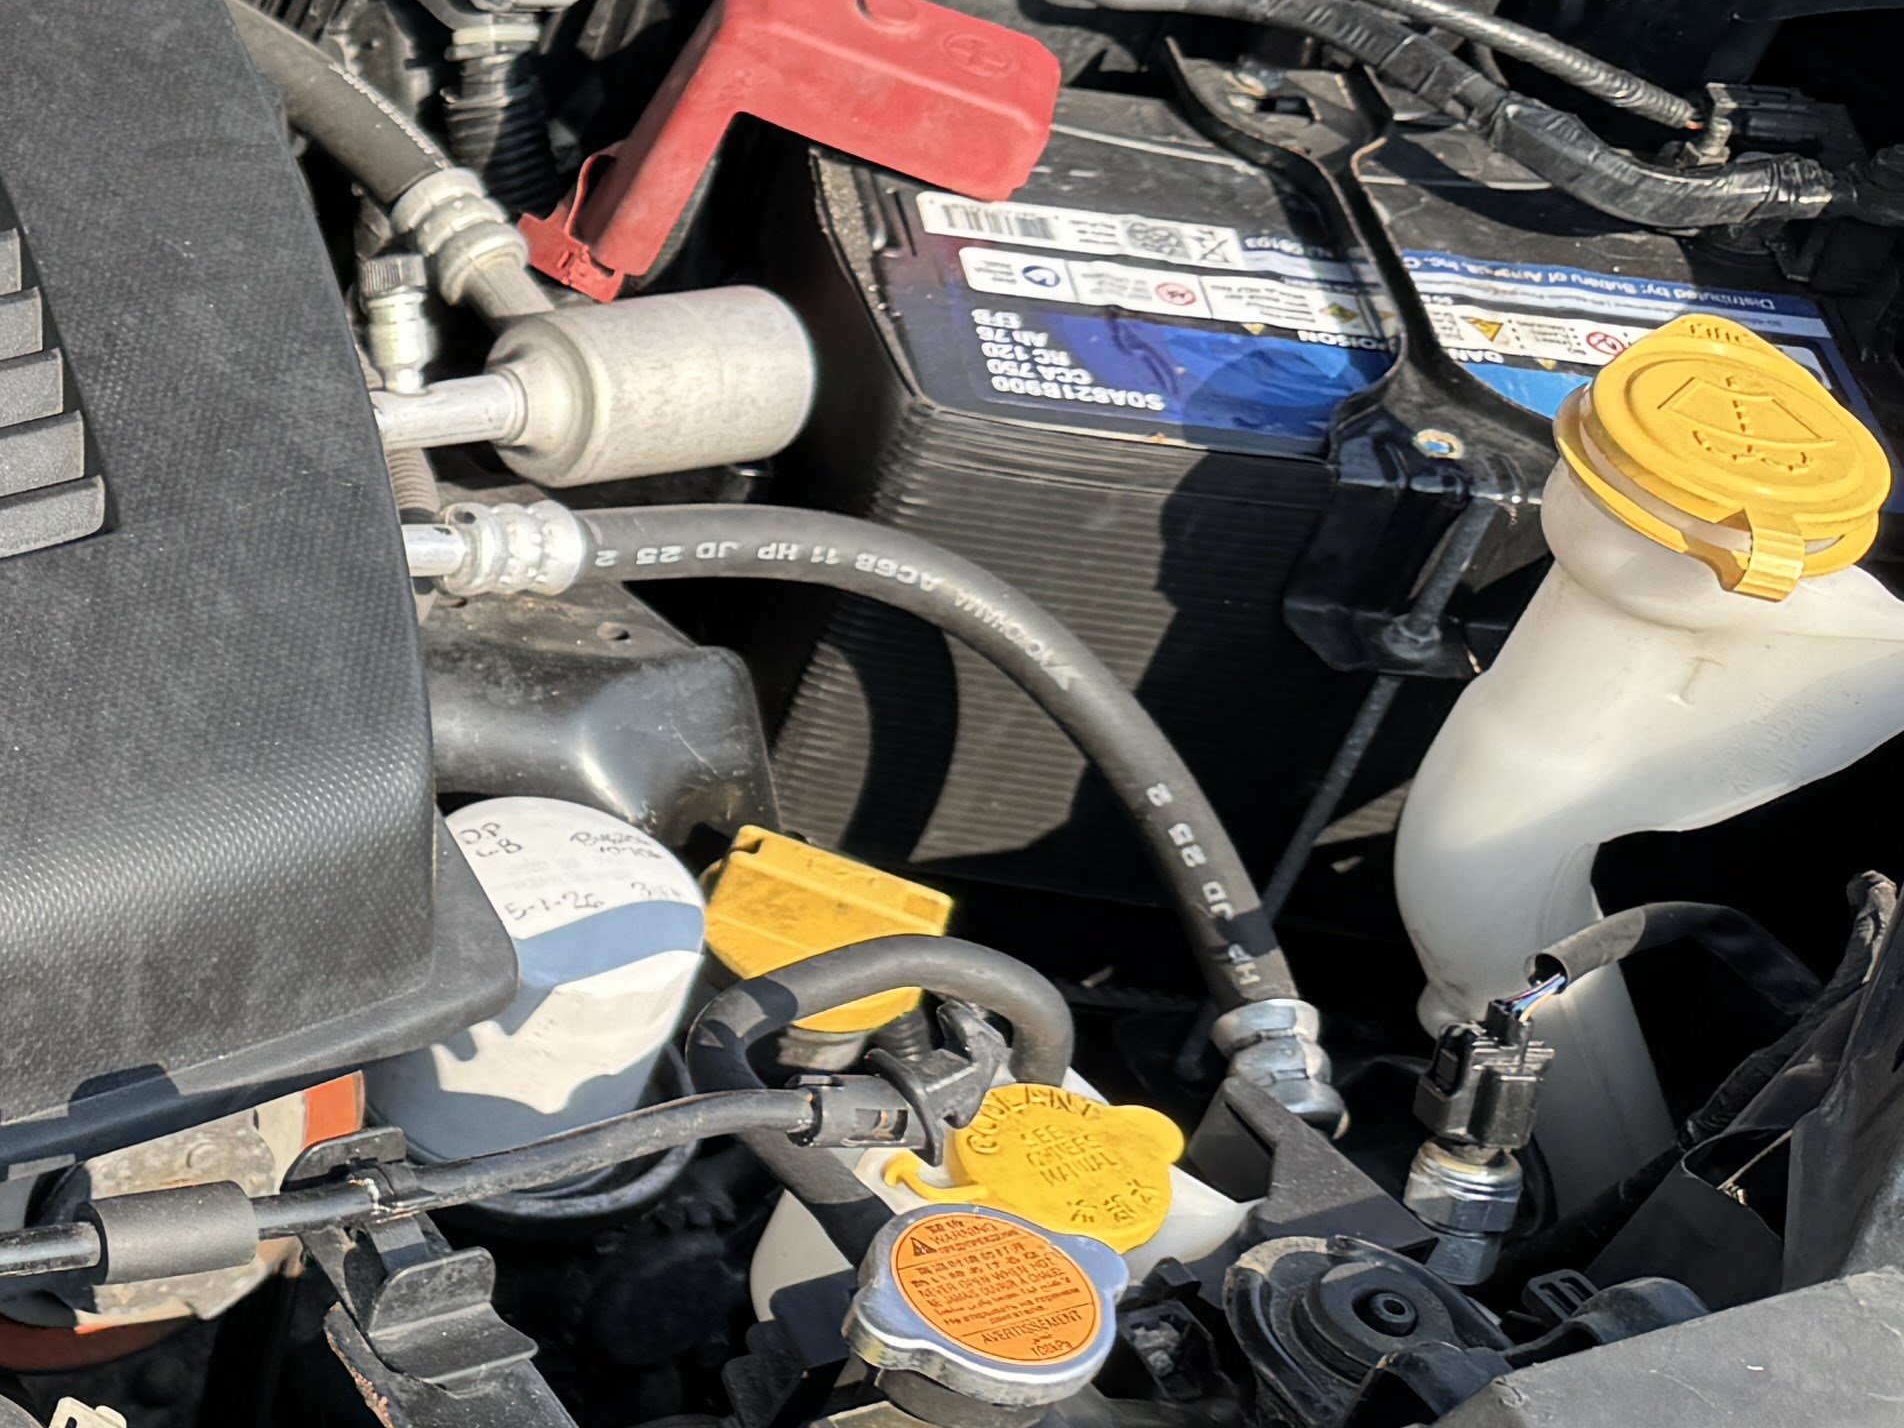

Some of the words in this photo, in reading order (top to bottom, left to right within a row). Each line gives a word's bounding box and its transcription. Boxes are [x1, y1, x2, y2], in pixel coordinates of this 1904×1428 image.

[1549, 269, 1570, 285] of
[1581, 274, 1641, 297] Subaru
[981, 341, 1029, 361] 120
[1031, 348, 1072, 368] RC
[986, 358, 1037, 380] 750
[1036, 364, 1094, 385] CCA
[594, 550, 619, 568] 2
[635, 545, 683, 566] 25
[695, 541, 740, 560] JD
[757, 541, 800, 563] HP
[953, 588, 1056, 667] YOKOHAMA
[1201, 880, 1235, 922] JD
[1228, 943, 1261, 985] HP
[1020, 1124, 1064, 1147] SEE
[1039, 1151, 1119, 1187] MANUAL
[981, 1309, 1084, 1346] AVERTISSEMENT
